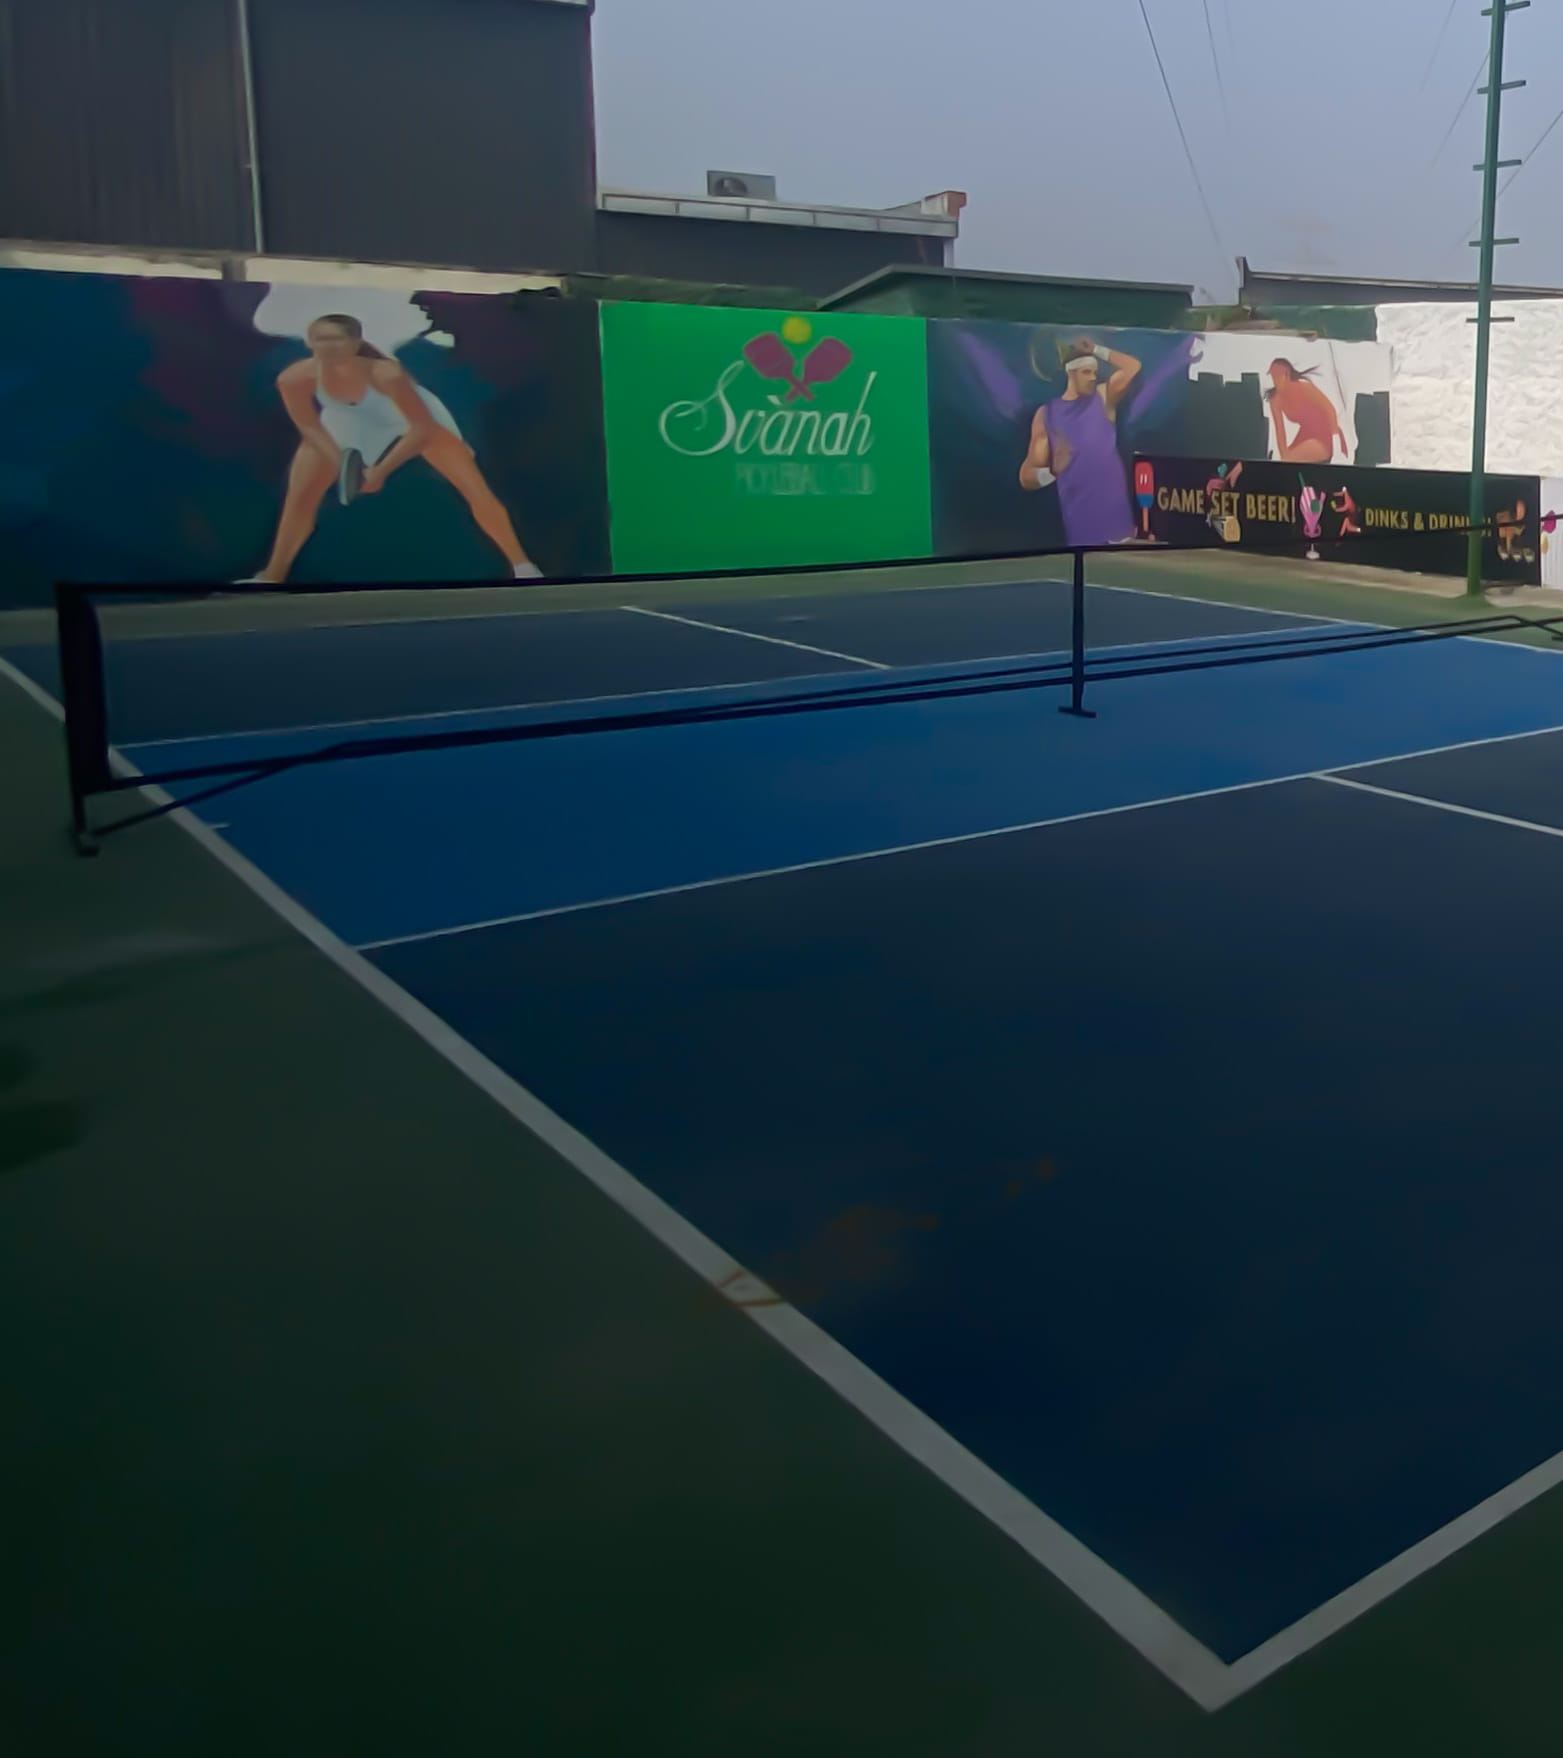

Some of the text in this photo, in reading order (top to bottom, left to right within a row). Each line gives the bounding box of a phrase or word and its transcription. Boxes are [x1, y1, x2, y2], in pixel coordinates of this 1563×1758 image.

[1157, 486, 1296, 524] GAME SET BEER!
[1365, 507, 1409, 530] DINKS
[1413, 511, 1425, 532] &
